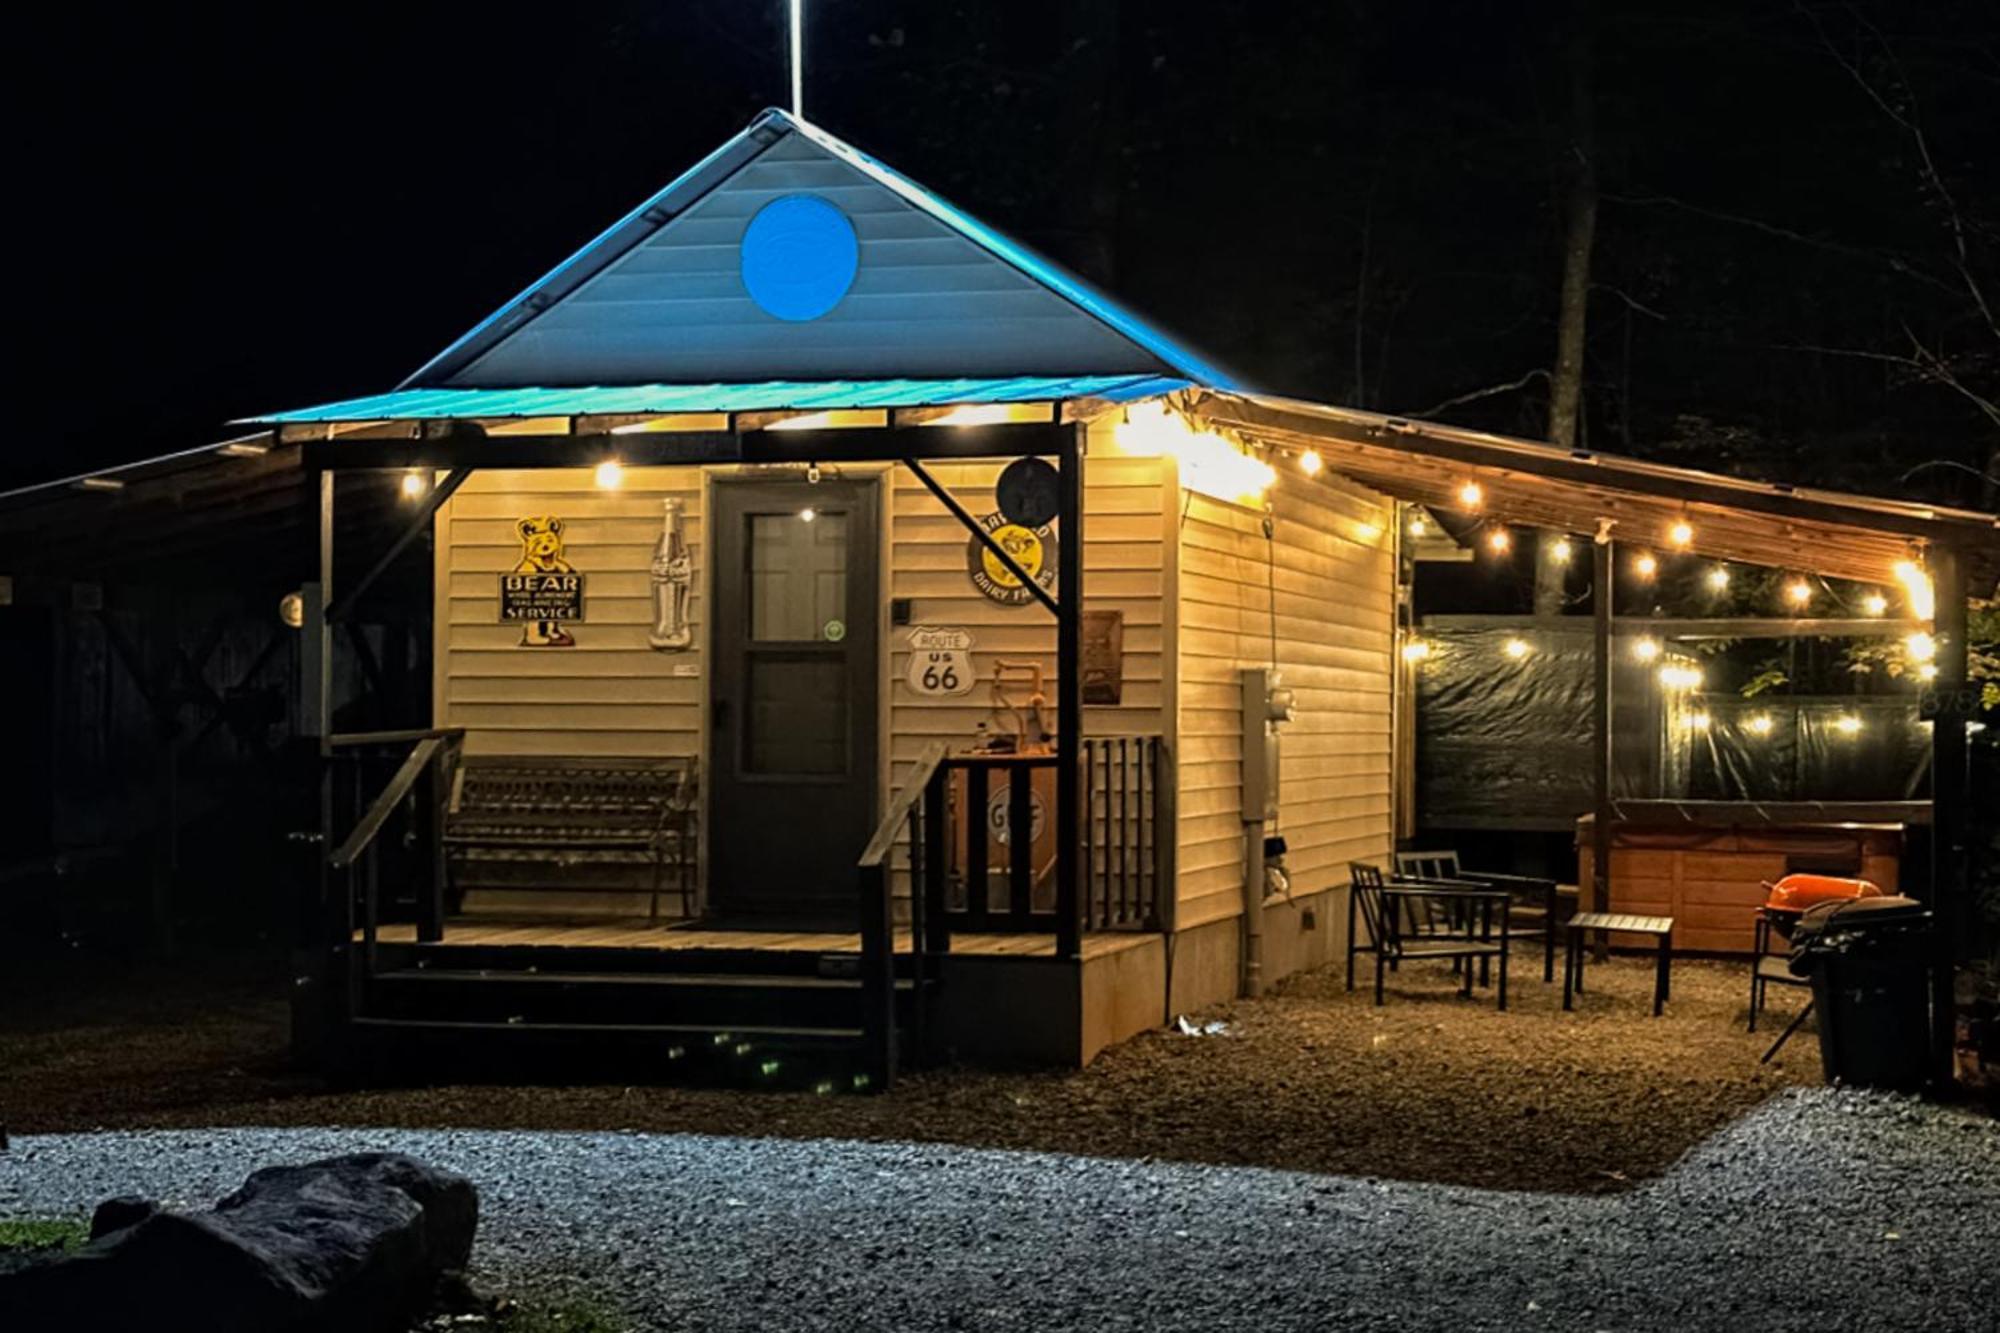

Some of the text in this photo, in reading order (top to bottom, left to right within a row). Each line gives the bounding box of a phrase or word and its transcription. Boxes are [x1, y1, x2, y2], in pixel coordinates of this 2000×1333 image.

[507, 577, 577, 591] BEAR
[972, 571, 1009, 600] DAIRY
[507, 607, 577, 619] SERVICE
[921, 634, 961, 646] ROUTE
[929, 652, 952, 663] US
[923, 666, 958, 690] 66
